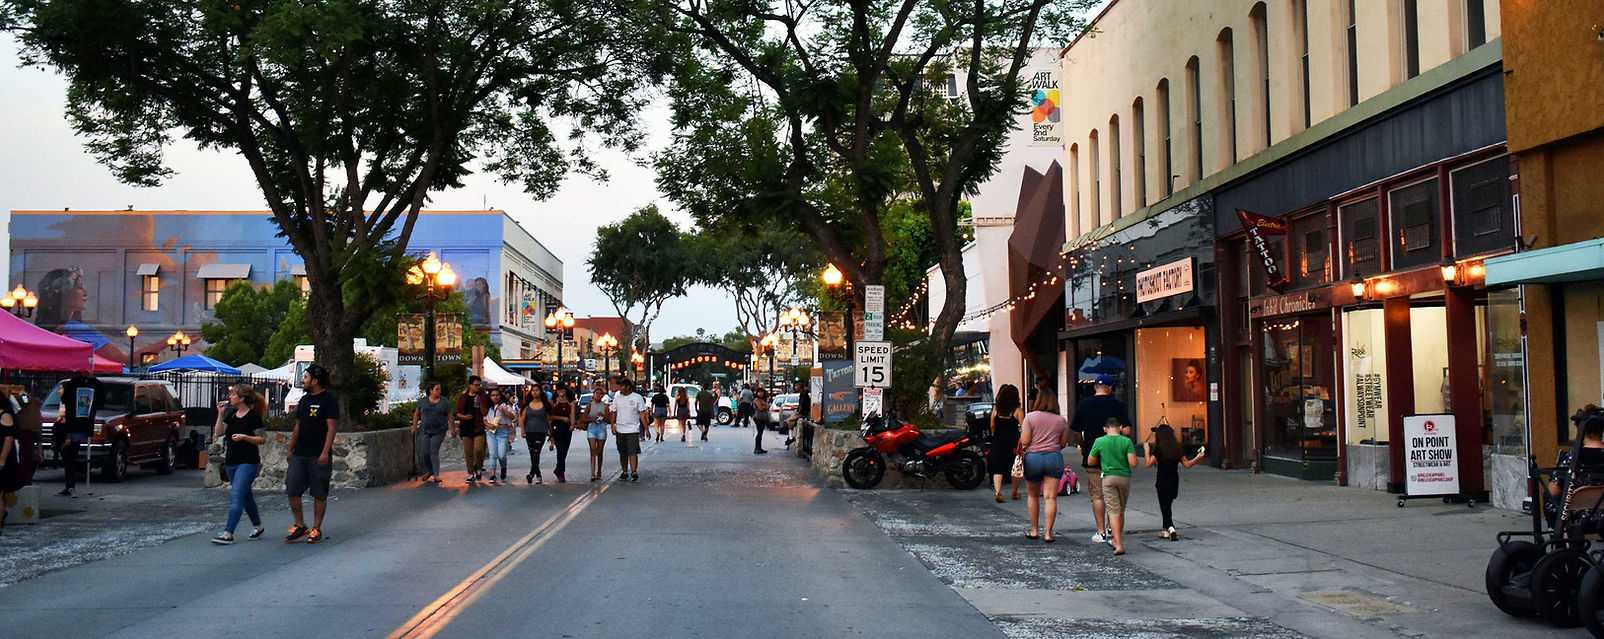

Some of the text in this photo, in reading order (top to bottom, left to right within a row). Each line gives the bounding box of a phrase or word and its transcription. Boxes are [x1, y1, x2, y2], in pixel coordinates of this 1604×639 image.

[1032, 80, 1059, 89] WALK
[1033, 72, 1051, 81] ART
[1033, 123, 1054, 131] Every
[1033, 135, 1061, 143] Saturday
[1250, 227, 1277, 274] TATTOO
[1163, 265, 1183, 291] FACTORY
[1280, 292, 1316, 314] Chronicles
[858, 346, 889, 354] SPEED
[670, 355, 744, 370] ANTIQUE ROW
[826, 365, 854, 382] TATTOO
[862, 366, 884, 383] 15
[1365, 374, 1374, 419] #STREETWEAR
[1373, 373, 1382, 409] #GYMWEAR
[828, 403, 856, 415] GALLERY
[1356, 374, 1366, 428] #ALWAYSONPOINT
[1412, 436, 1449, 448] ON POINT
[1410, 449, 1452, 461] ART SHOW
[1561, 481, 1575, 521] SECURITY
